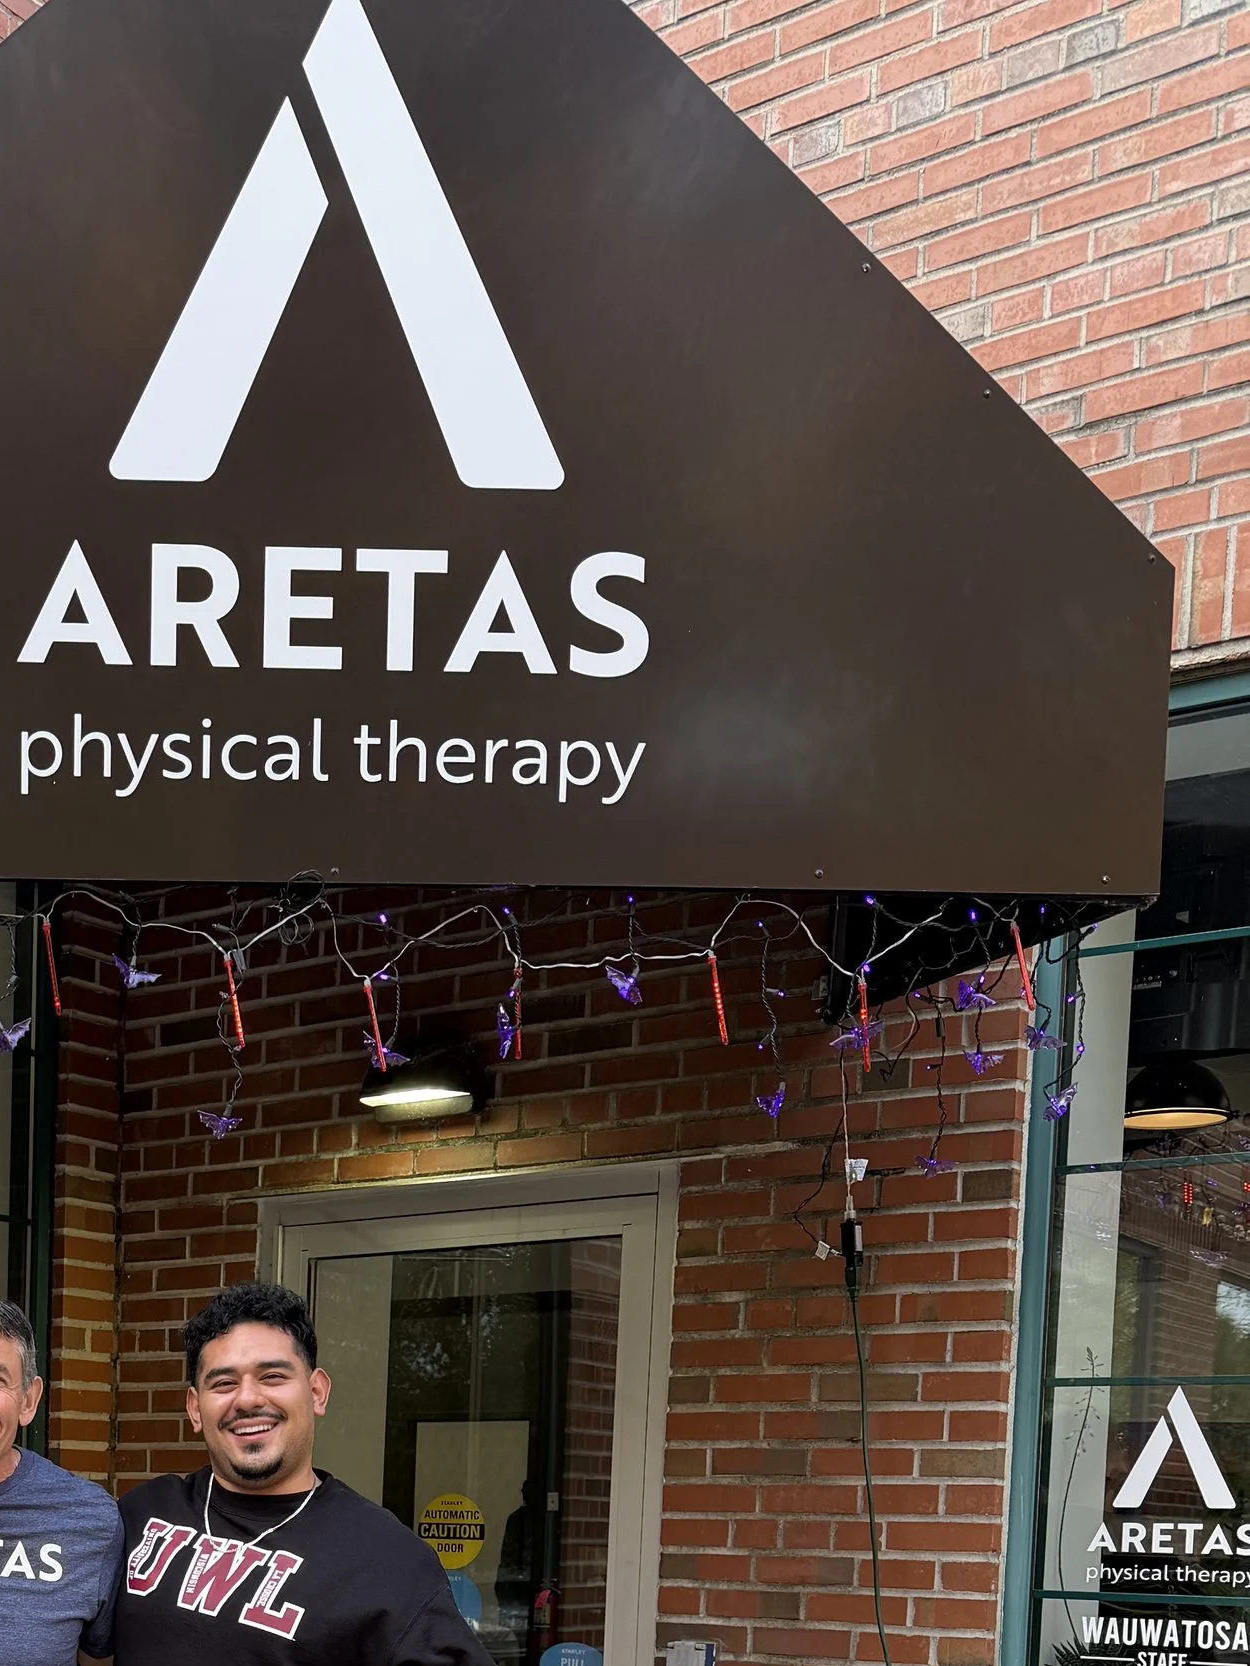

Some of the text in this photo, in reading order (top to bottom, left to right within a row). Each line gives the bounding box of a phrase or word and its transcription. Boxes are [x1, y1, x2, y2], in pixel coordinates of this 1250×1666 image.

[17, 539, 650, 678] ARETAS
[20, 713, 646, 805] physical therapy
[420, 1524, 481, 1538] CAUTION
[424, 1510, 480, 1520] AUTOMATIC
[437, 1543, 464, 1553] DOOR
[1086, 1522, 1250, 1556] ARETAS
[126, 1517, 305, 1641] UWL
[1086, 1563, 1169, 1584] physical
[1082, 1616, 1249, 1651] WAUWATOSA
